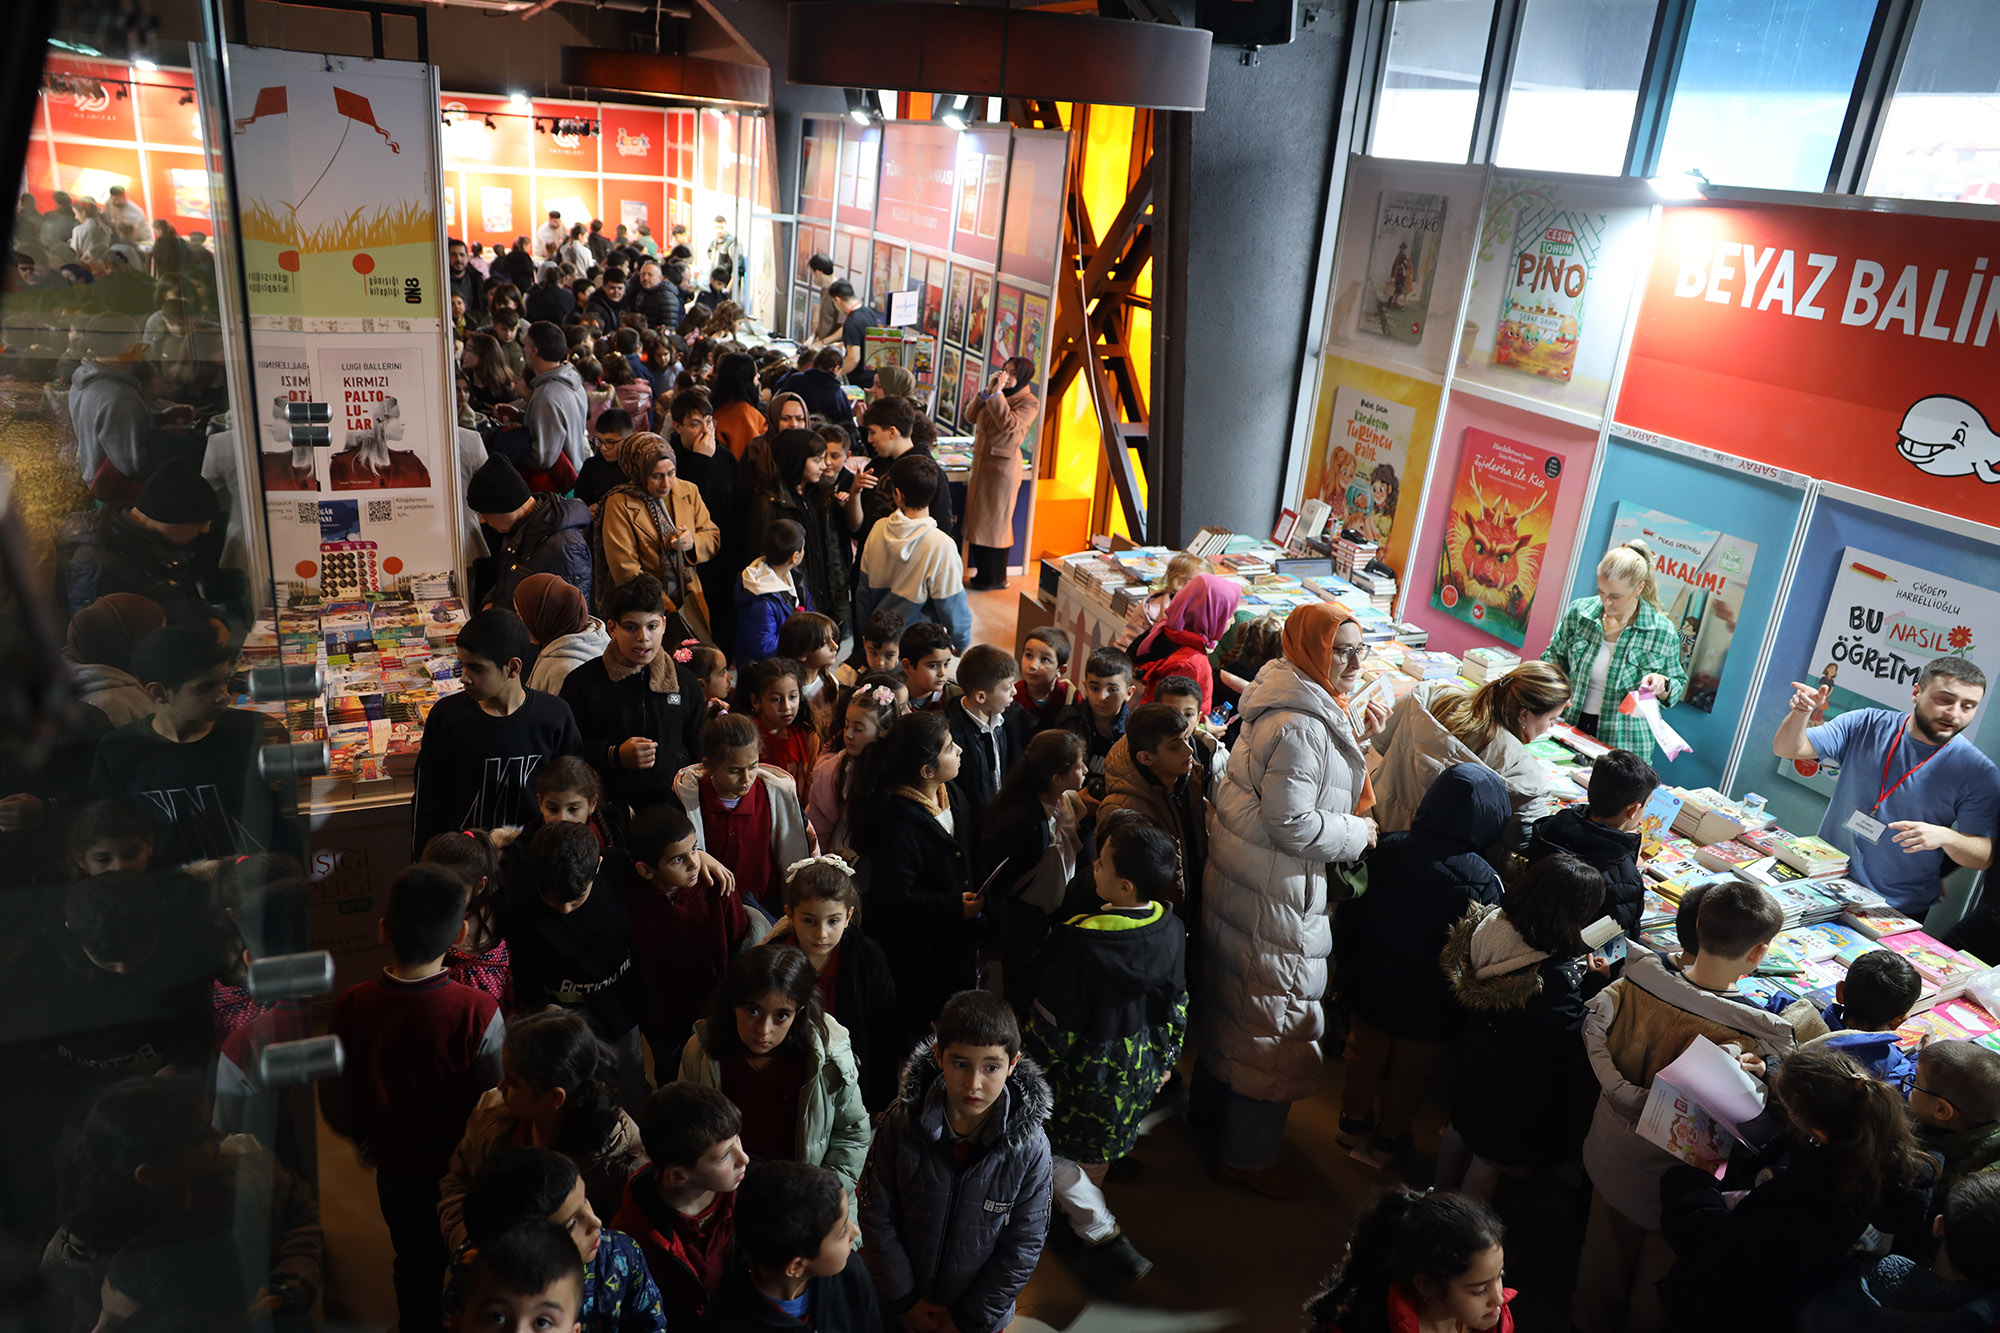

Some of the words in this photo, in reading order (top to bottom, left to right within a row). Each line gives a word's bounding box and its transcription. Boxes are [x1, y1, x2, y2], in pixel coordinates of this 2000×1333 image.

[1546, 229, 1574, 243] CESUR
[1541, 242, 1573, 256] TOHUM
[1674, 240, 1838, 321] BEYAZ
[342, 363, 361, 371] LUIGI
[363, 362, 402, 371] BALLERINI
[343, 376, 389, 387] KIRMIZI
[345, 390, 391, 402] PALTO-
[346, 405, 368, 417] LU-
[347, 418, 372, 430] LAR
[1625, 428, 1658, 444] SARAY
[1513, 467, 1527, 481] ile
[1738, 460, 1778, 478] SARAY
[1652, 551, 1727, 596] AKALIM!
[1912, 581, 1948, 598] ÇİĞDEM
[1896, 589, 1961, 615] HARBELLİOĞLU
[1849, 605, 1885, 634] BU
[1889, 623, 1948, 652] NASIL
[1831, 635, 1922, 686] ÖĞRETM
[309, 848, 369, 875] IŞIĞI
